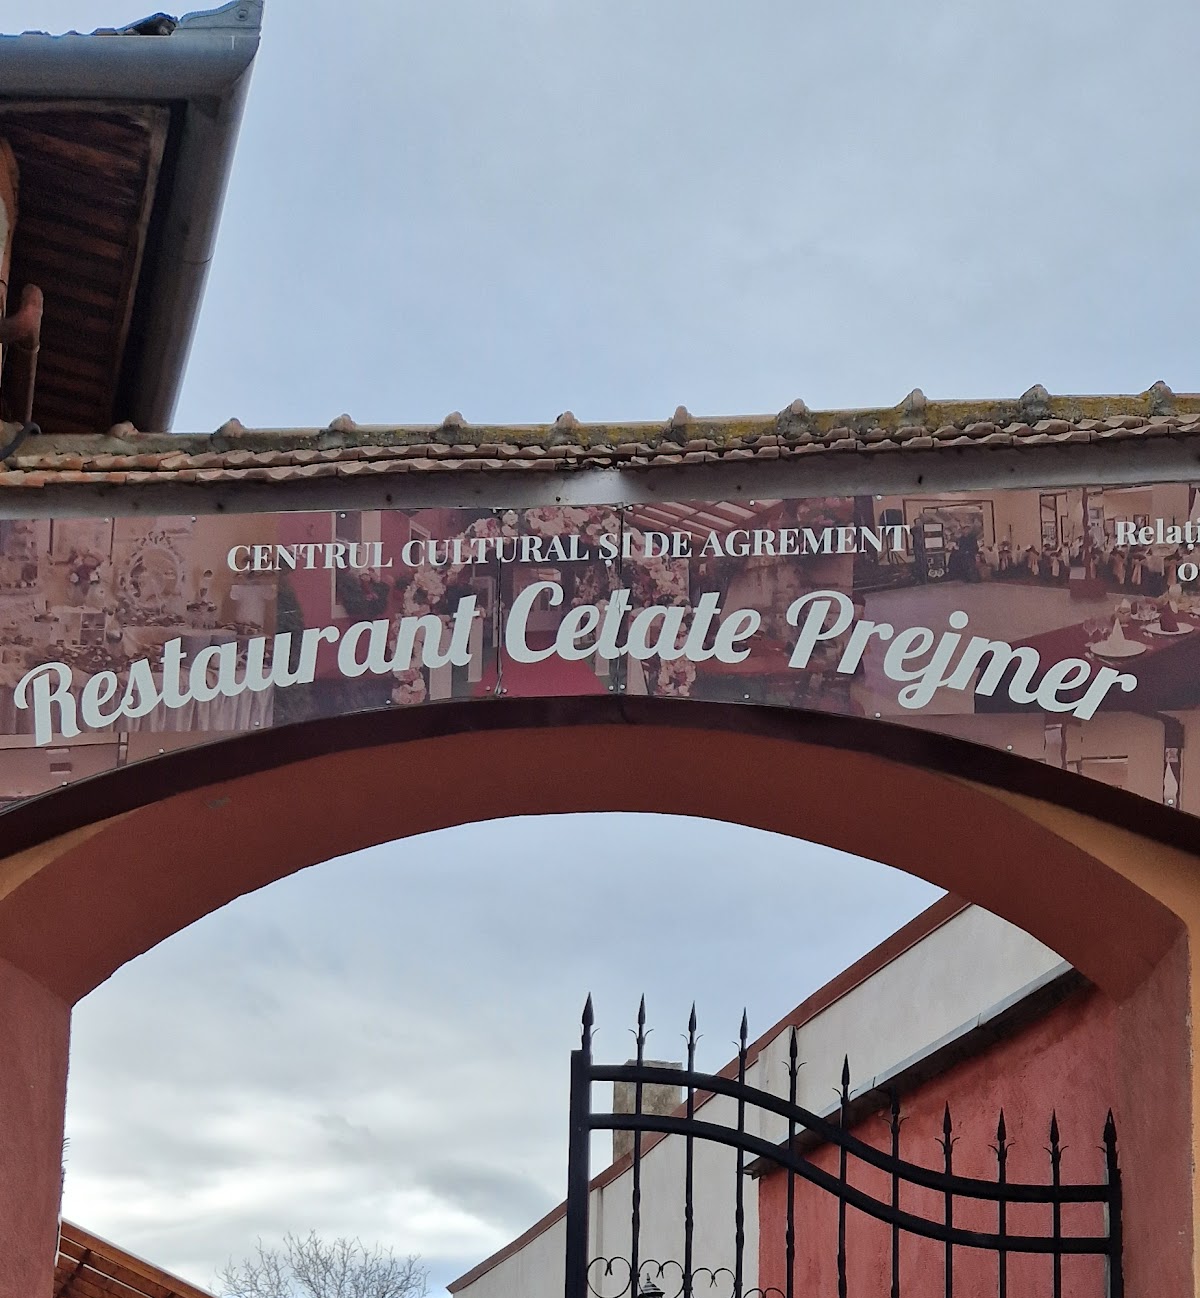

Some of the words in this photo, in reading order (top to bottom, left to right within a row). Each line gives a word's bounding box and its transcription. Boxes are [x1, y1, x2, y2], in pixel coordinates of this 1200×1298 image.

[227, 541, 392, 572] CENTRUL
[401, 534, 589, 567] CULTURAL
[599, 532, 632, 567] ȘI
[643, 531, 692, 558] DE
[698, 525, 911, 557] AGREMENT
[14, 594, 480, 747] Restaurant
[505, 580, 761, 663] Cetate
[786, 590, 1137, 721] Prejmer
